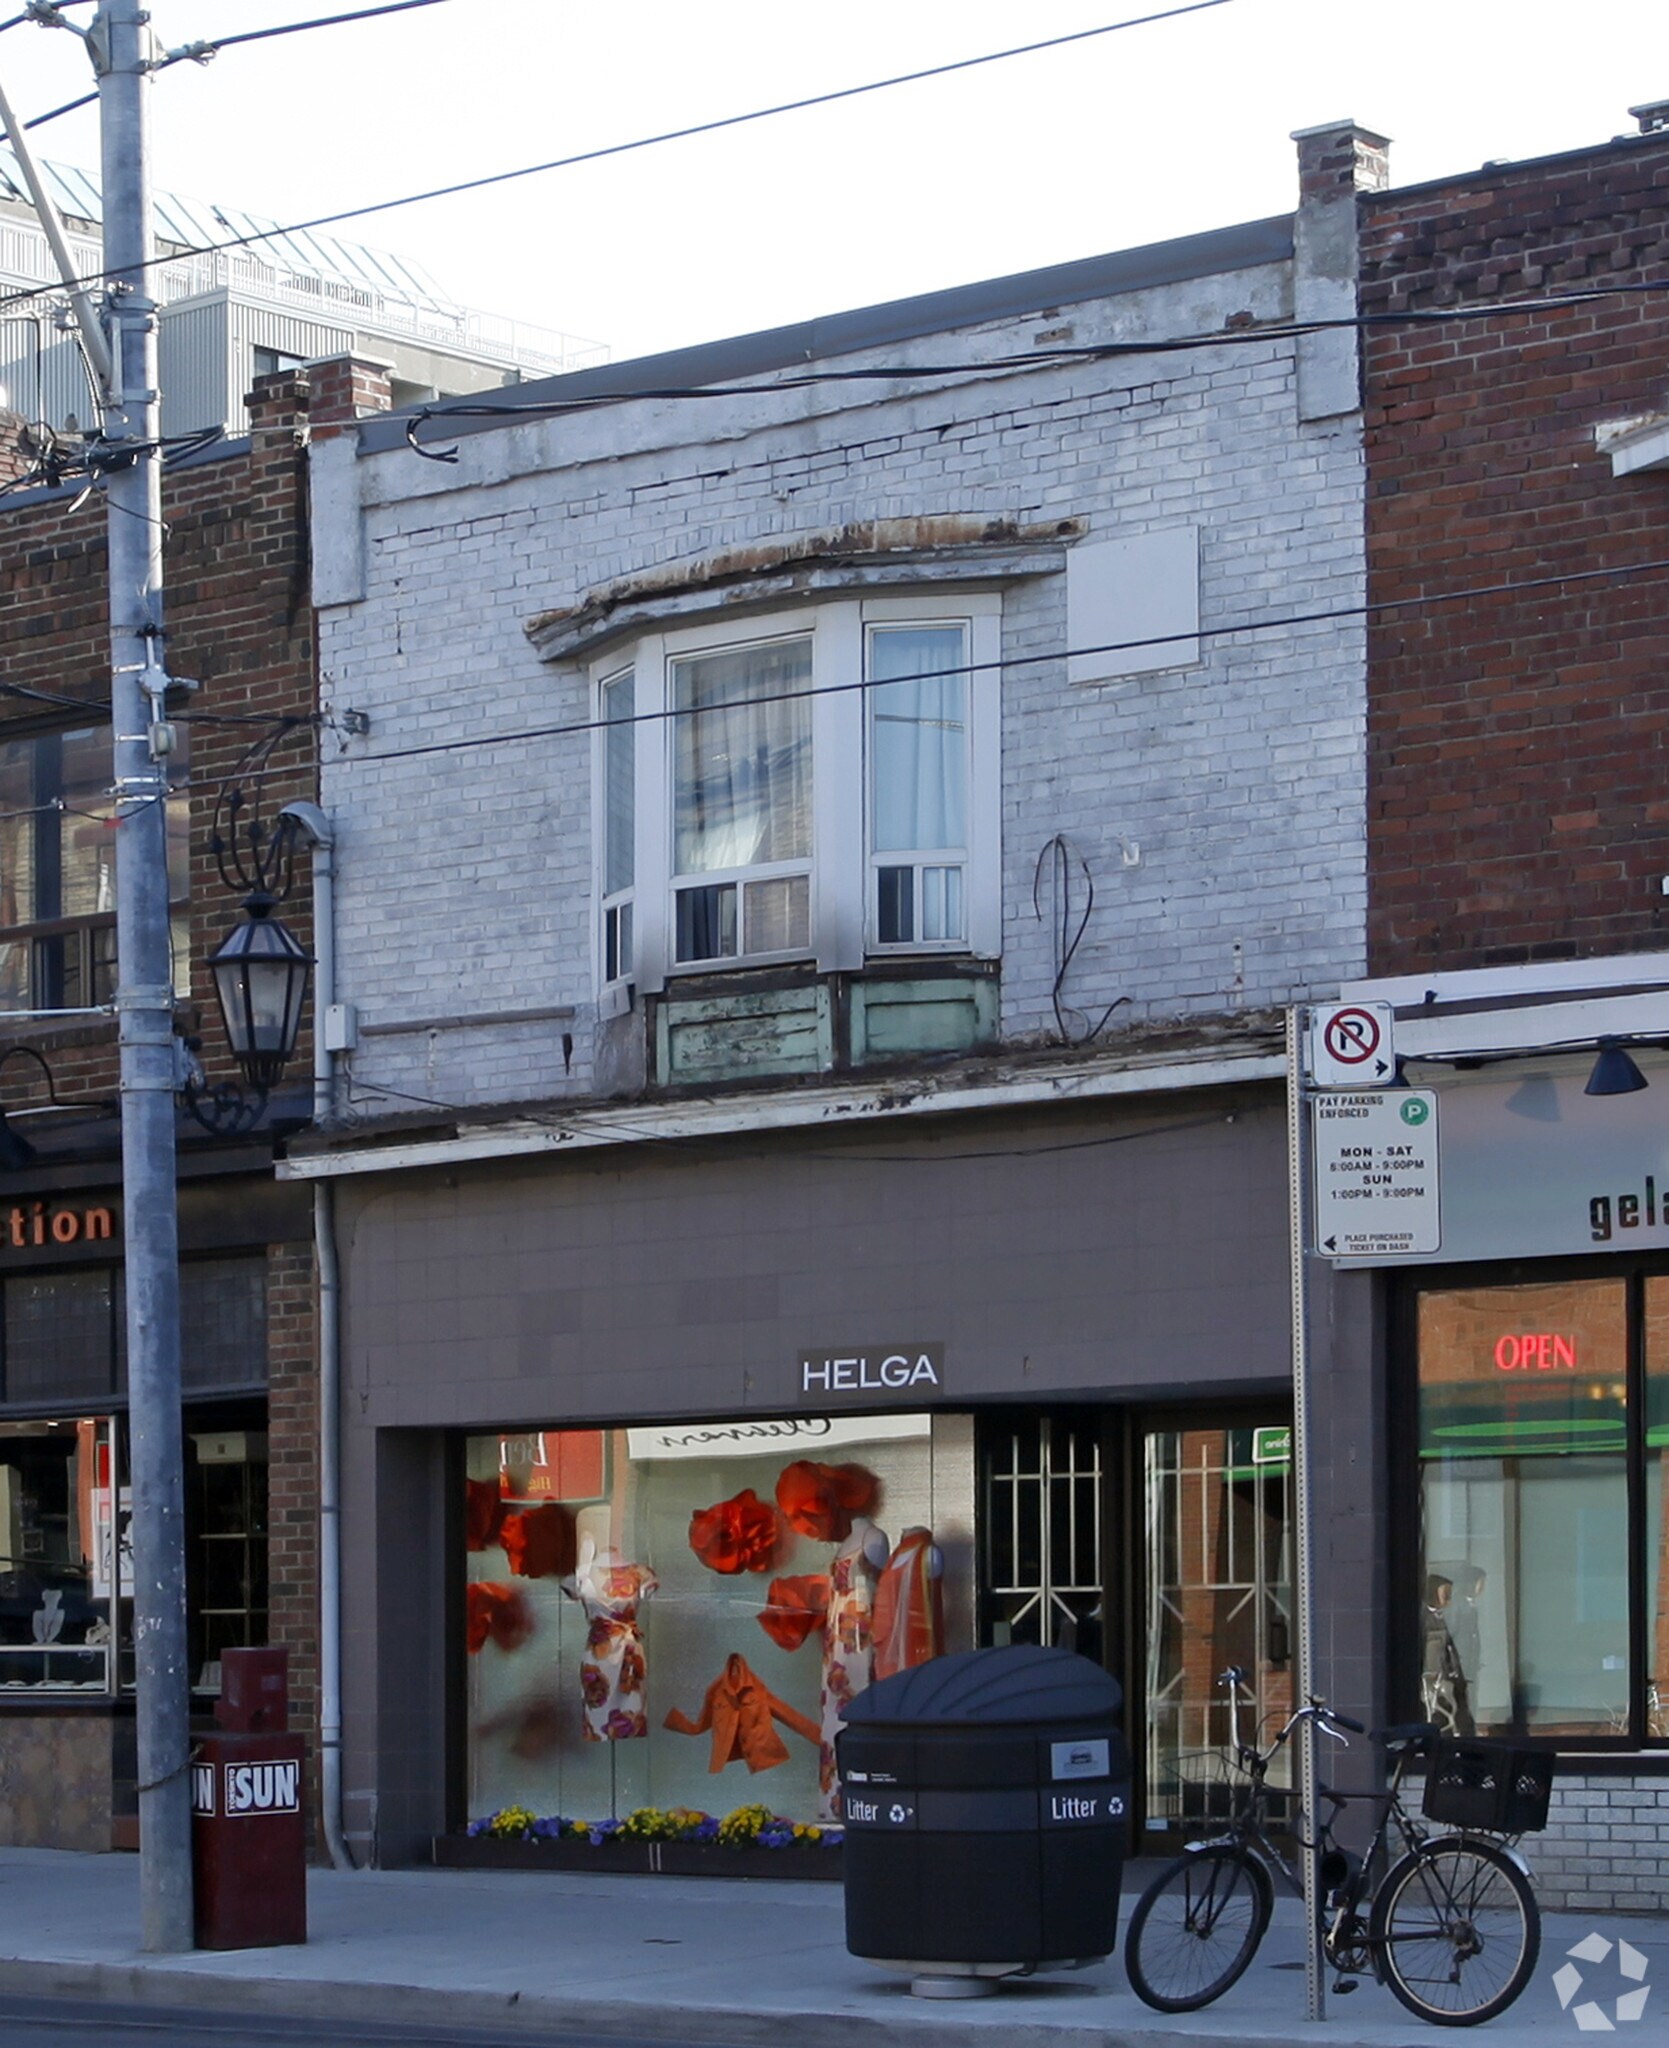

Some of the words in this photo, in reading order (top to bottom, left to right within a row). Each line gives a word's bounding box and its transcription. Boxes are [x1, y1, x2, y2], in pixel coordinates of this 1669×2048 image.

[1319, 1097, 1338, 1106] PAY
[1341, 1096, 1384, 1105] PARKING
[1320, 1108, 1369, 1119] ENFORCED
[1340, 1147, 1373, 1157] MON
[1386, 1146, 1413, 1156] SAT
[1382, 1159, 1424, 1170] 9:00PM
[1363, 1174, 1393, 1185] SUN
[1331, 1189, 1372, 1199] 1:00PM
[1382, 1187, 1424, 1198] 9:00PM
[1494, 1334, 1577, 1370] OPEN
[803, 1354, 938, 1391] HELGA
[236, 1764, 295, 1809] SUN
[847, 1797, 879, 1821] Litter
[1052, 1797, 1097, 1819] Litter
